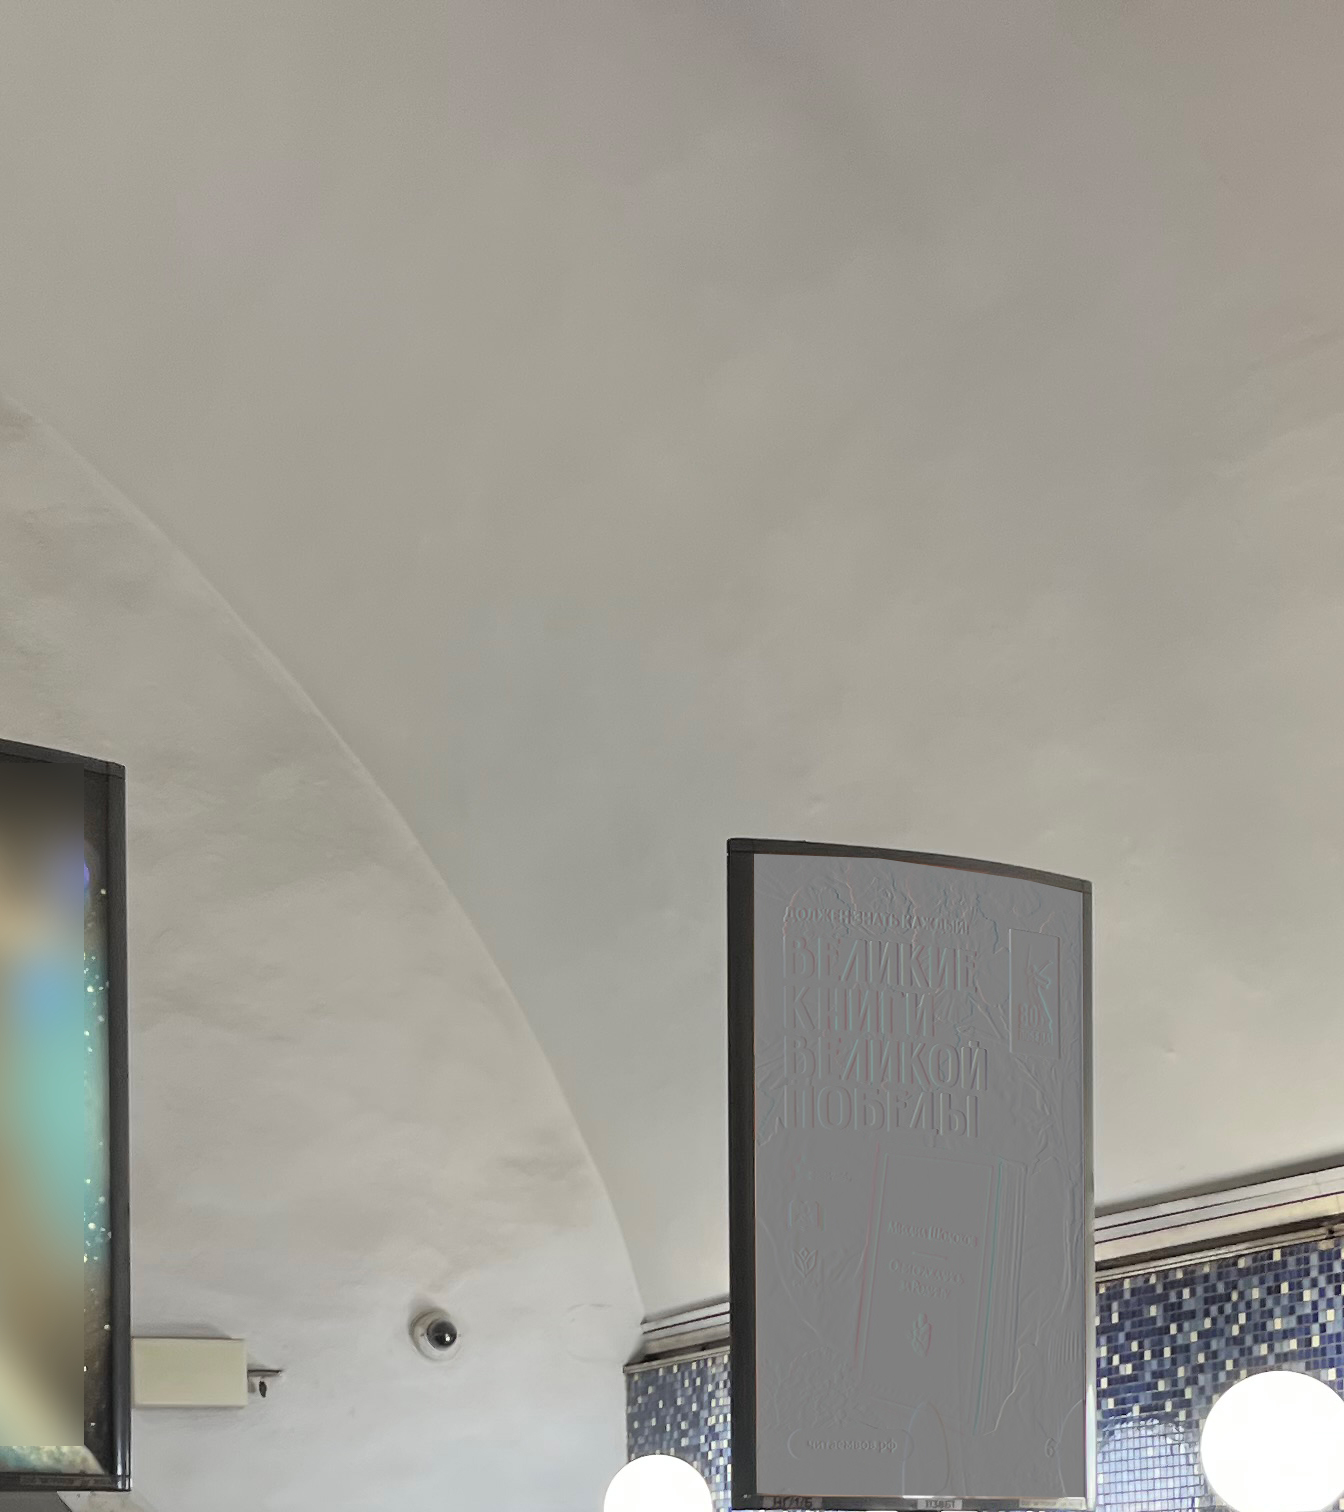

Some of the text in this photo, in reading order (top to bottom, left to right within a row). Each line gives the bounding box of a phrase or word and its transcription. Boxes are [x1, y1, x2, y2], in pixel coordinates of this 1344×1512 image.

[784, 935, 977, 993] ВЕЛИКИЕ
[784, 986, 934, 1038] КНИГИ
[784, 1035, 987, 1091] ВЕЛИКОЙ
[785, 1085, 978, 1144] ПОБЕДЫ
